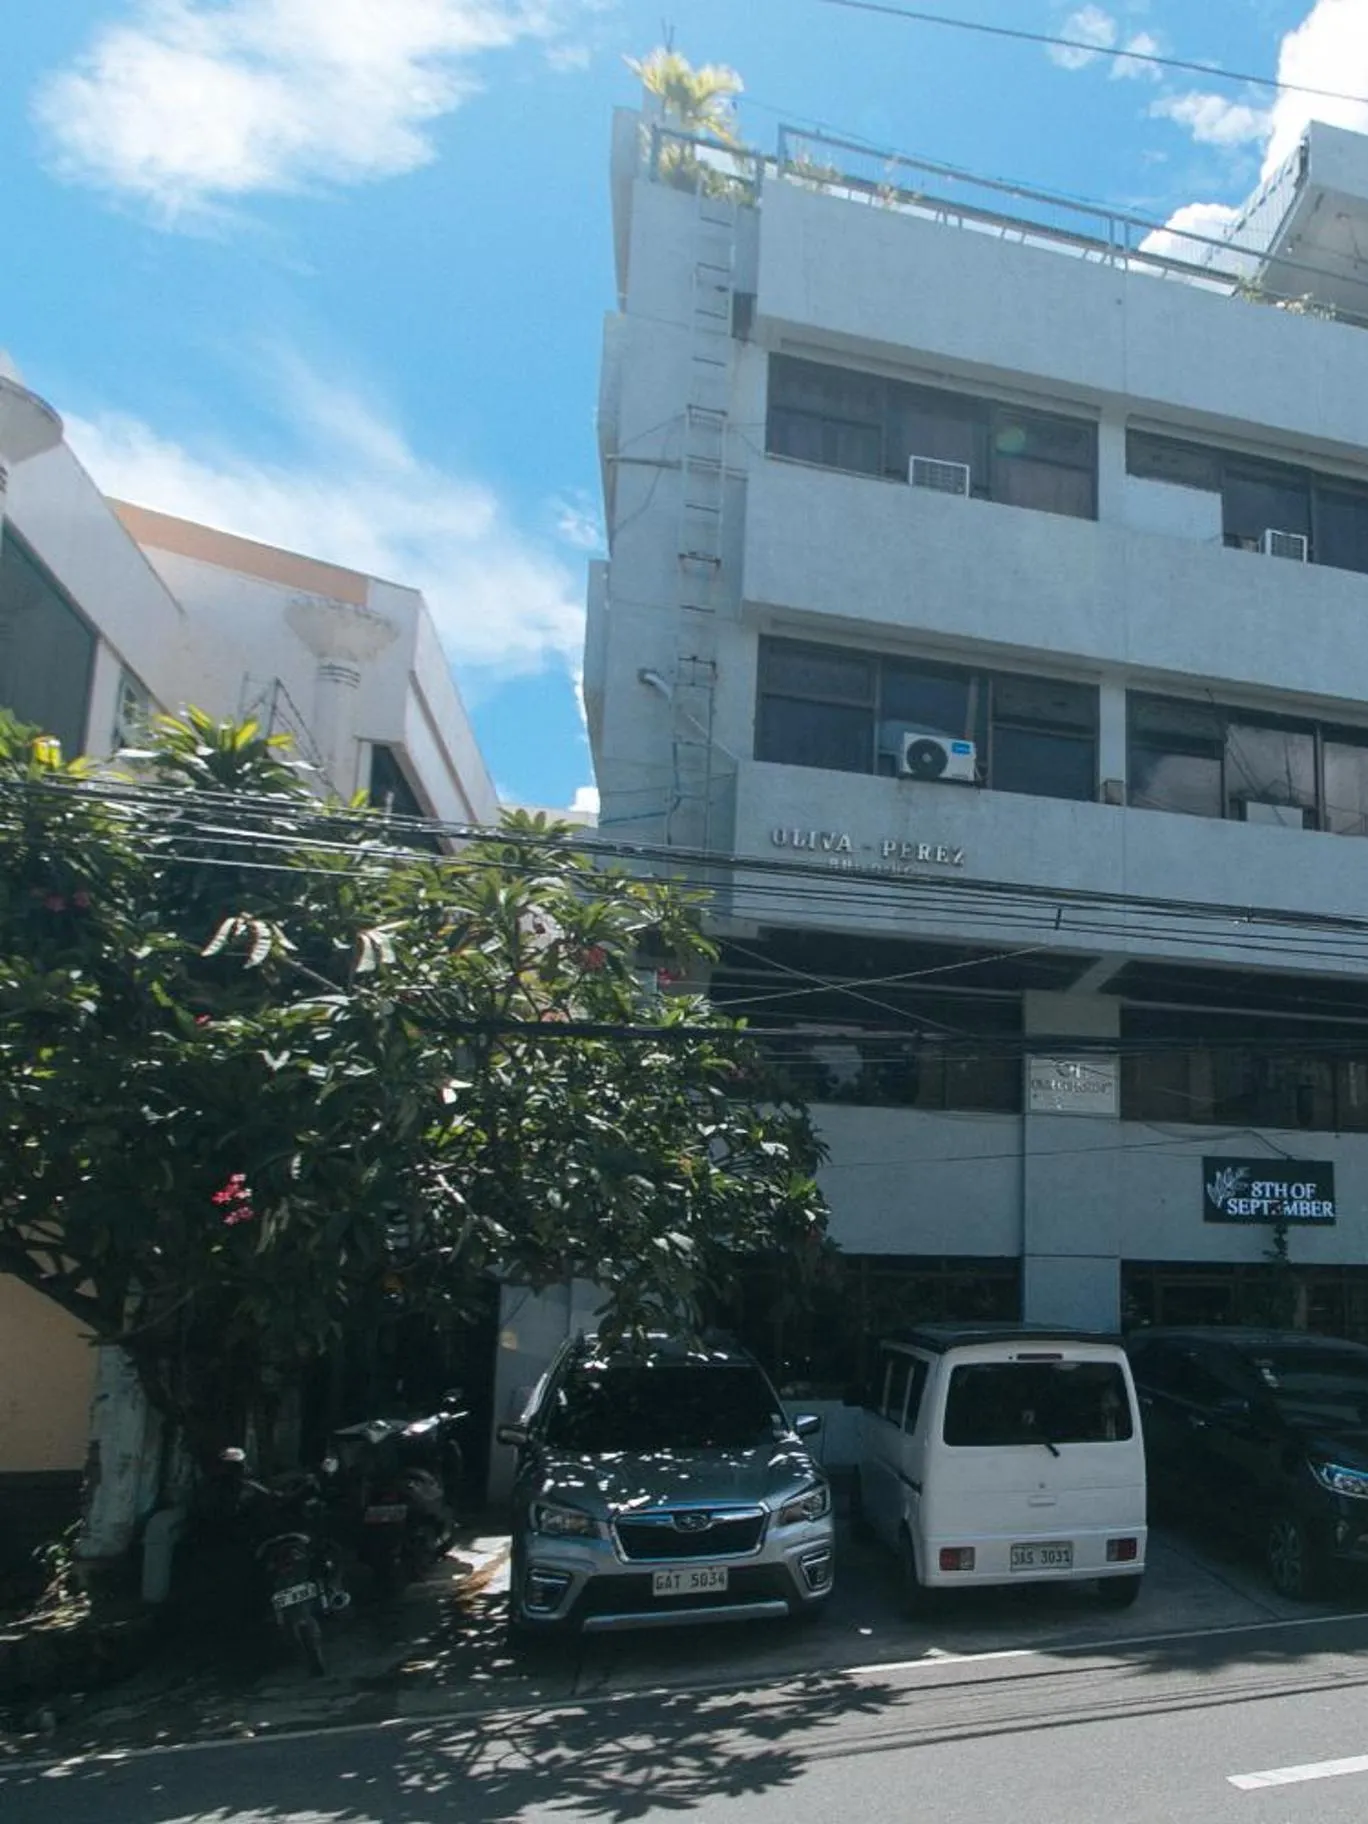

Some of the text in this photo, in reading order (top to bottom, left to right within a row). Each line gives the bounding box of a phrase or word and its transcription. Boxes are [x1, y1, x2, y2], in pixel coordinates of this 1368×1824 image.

[771, 826, 851, 852] OLIVA
[882, 838, 965, 867] PEREZ
[1250, 1180, 1317, 1200] 8TH OF
[655, 1575, 682, 1590] GAT
